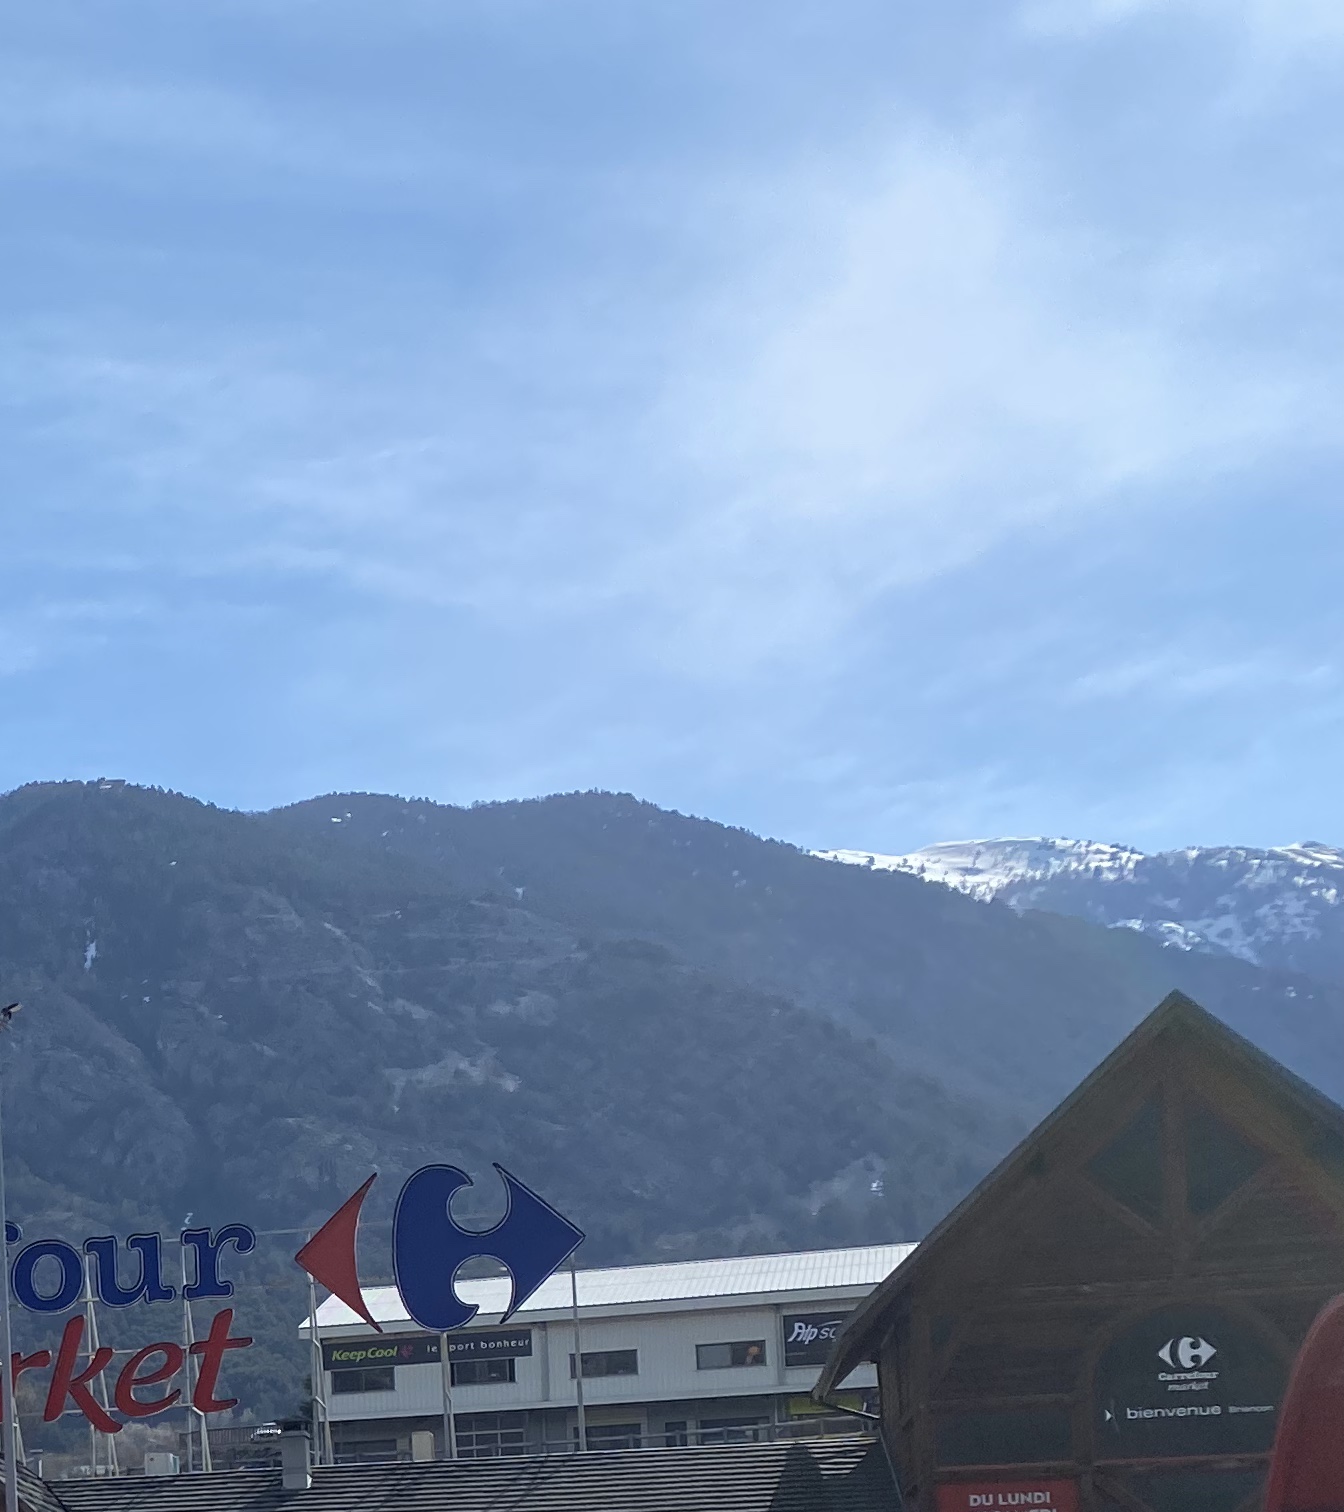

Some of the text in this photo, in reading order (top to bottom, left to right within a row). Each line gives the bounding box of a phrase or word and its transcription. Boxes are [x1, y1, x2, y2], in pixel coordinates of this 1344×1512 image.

[449, 1343, 475, 1354] port
[480, 1339, 529, 1349] bonheur
[1158, 1371, 1219, 1381] Carrefour
[1167, 1381, 1210, 1391] market
[1126, 1405, 1222, 1419] bienvenue
[969, 1492, 1050, 1507] DU LUNDI
